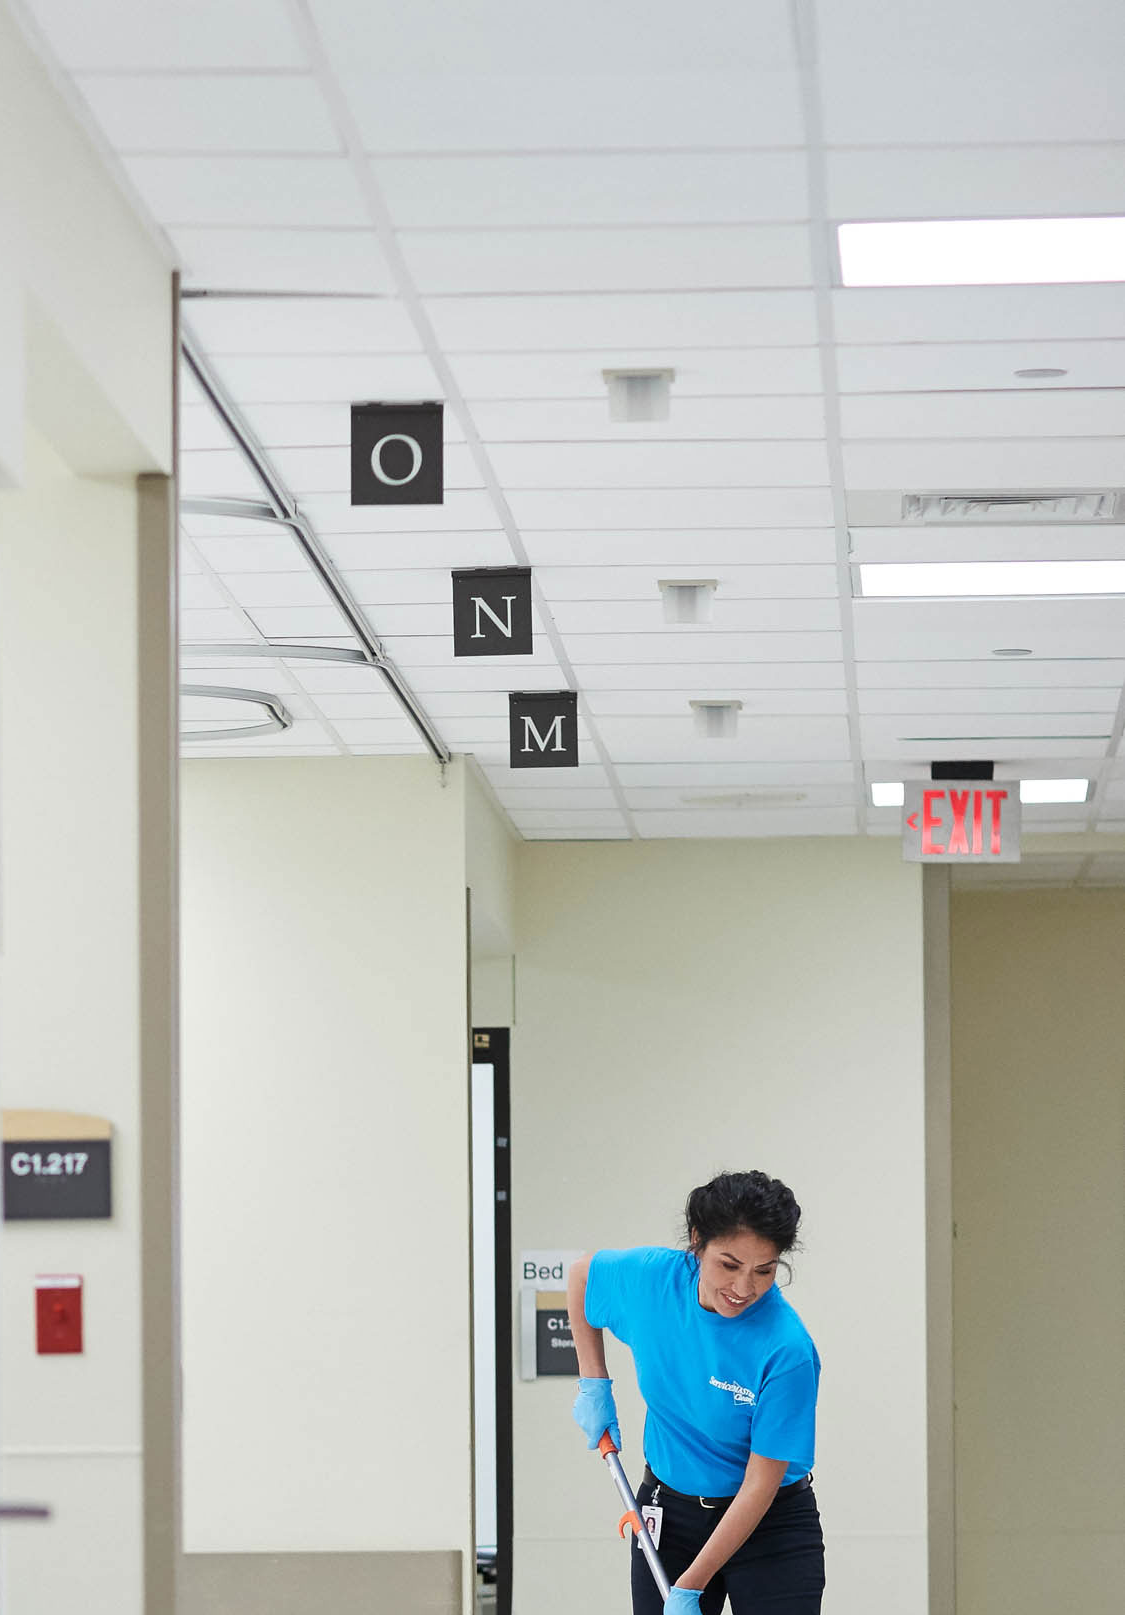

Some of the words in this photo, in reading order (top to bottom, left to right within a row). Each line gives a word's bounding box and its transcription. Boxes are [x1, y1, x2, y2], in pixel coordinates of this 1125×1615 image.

[370, 433, 423, 486] O
[470, 595, 517, 639] N
[520, 714, 567, 753] M
[921, 789, 1009, 855] EXIT
[10, 1151, 89, 1177] C1.217
[523, 1261, 564, 1281] Bed
